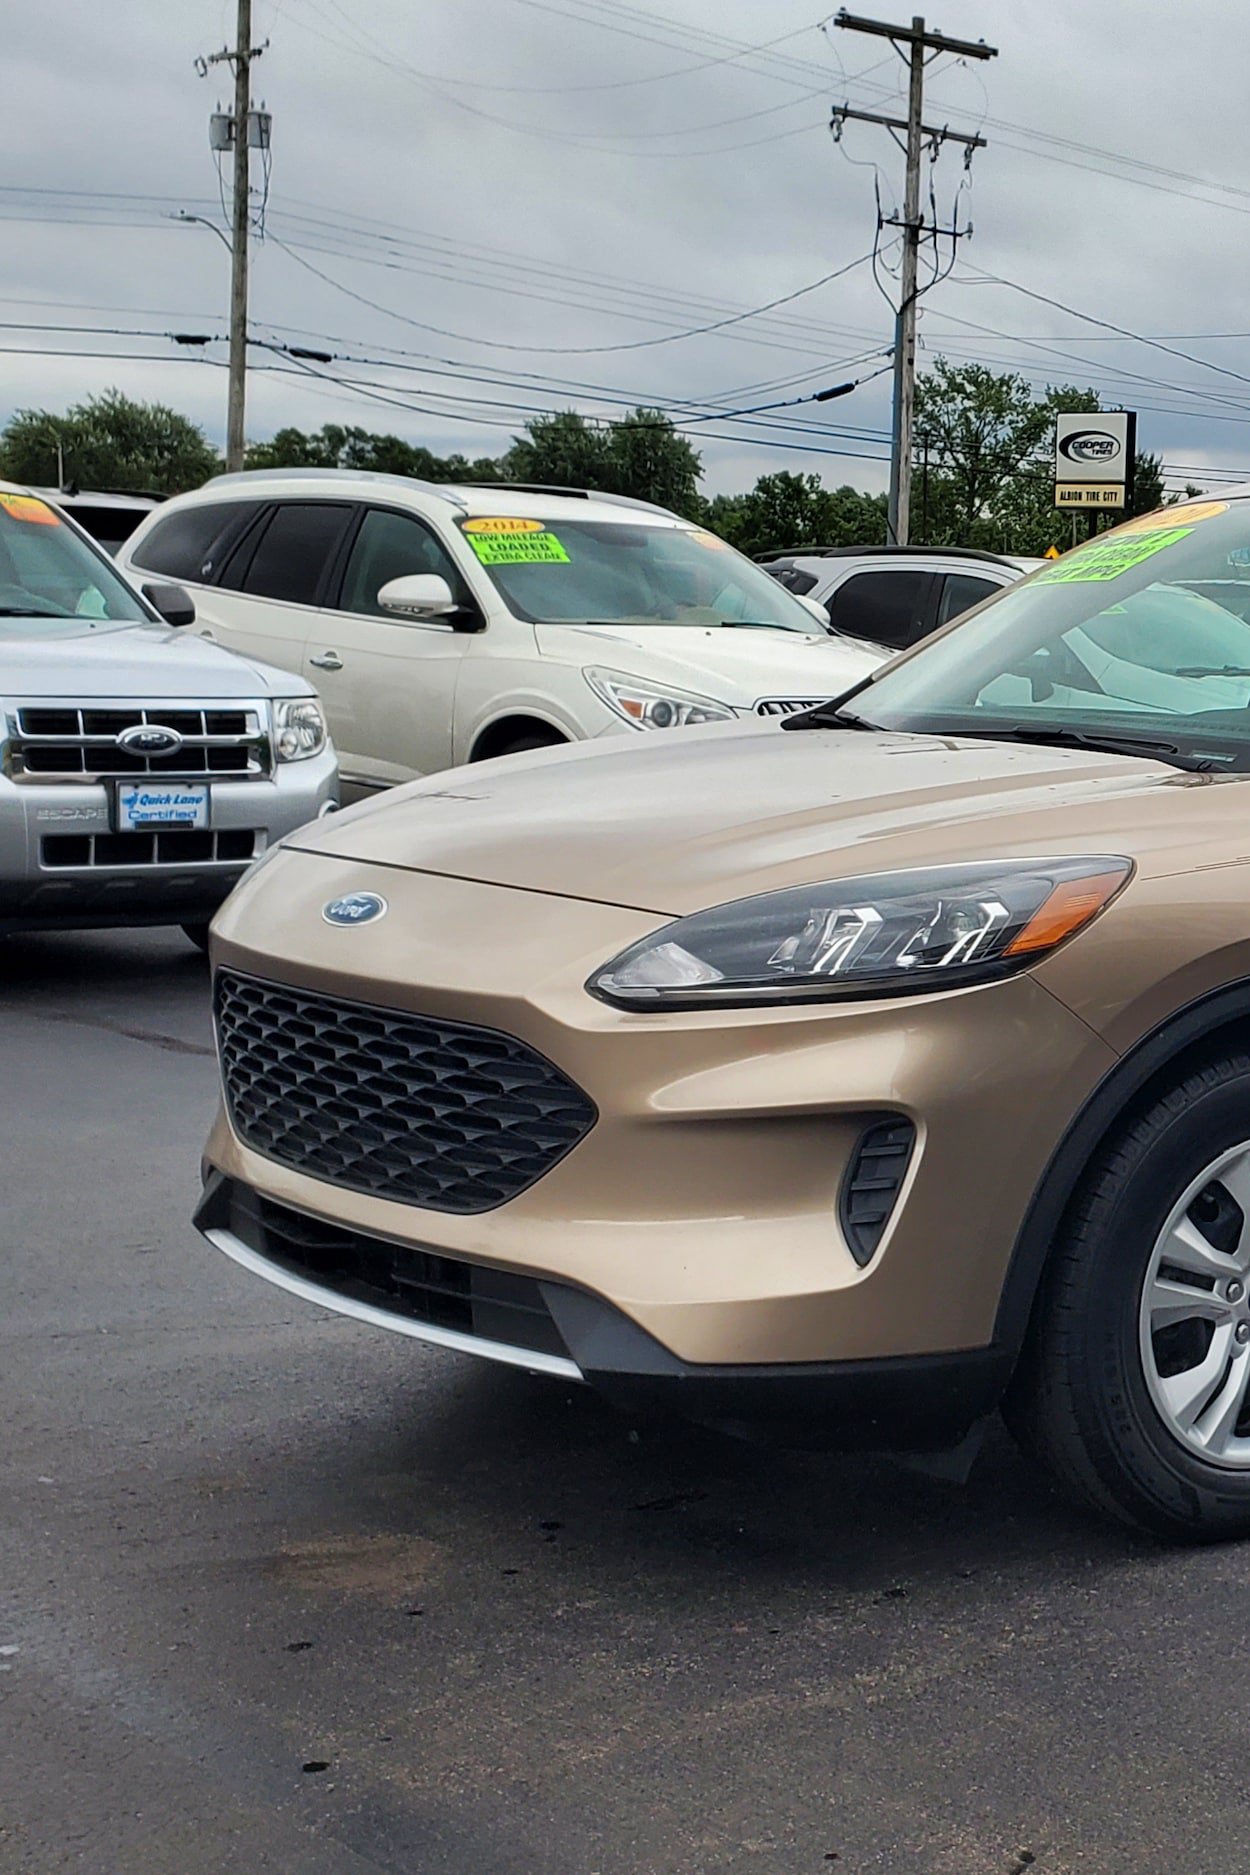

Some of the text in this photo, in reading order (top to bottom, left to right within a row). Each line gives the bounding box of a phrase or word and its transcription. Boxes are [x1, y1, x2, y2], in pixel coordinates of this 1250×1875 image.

[1072, 441, 1114, 449] COOPER
[1060, 491, 1118, 502] ALBION TIRE CITY
[481, 521, 528, 531] 2014
[474, 532, 548, 542] LOW MILEAGE
[488, 543, 549, 552] LOADED
[484, 552, 561, 562] EXTRA CLEAN
[140, 793, 203, 806] Quick Lane
[36, 807, 108, 820] ESCAPE
[128, 809, 197, 819] Certified
[330, 896, 372, 918] Ford
